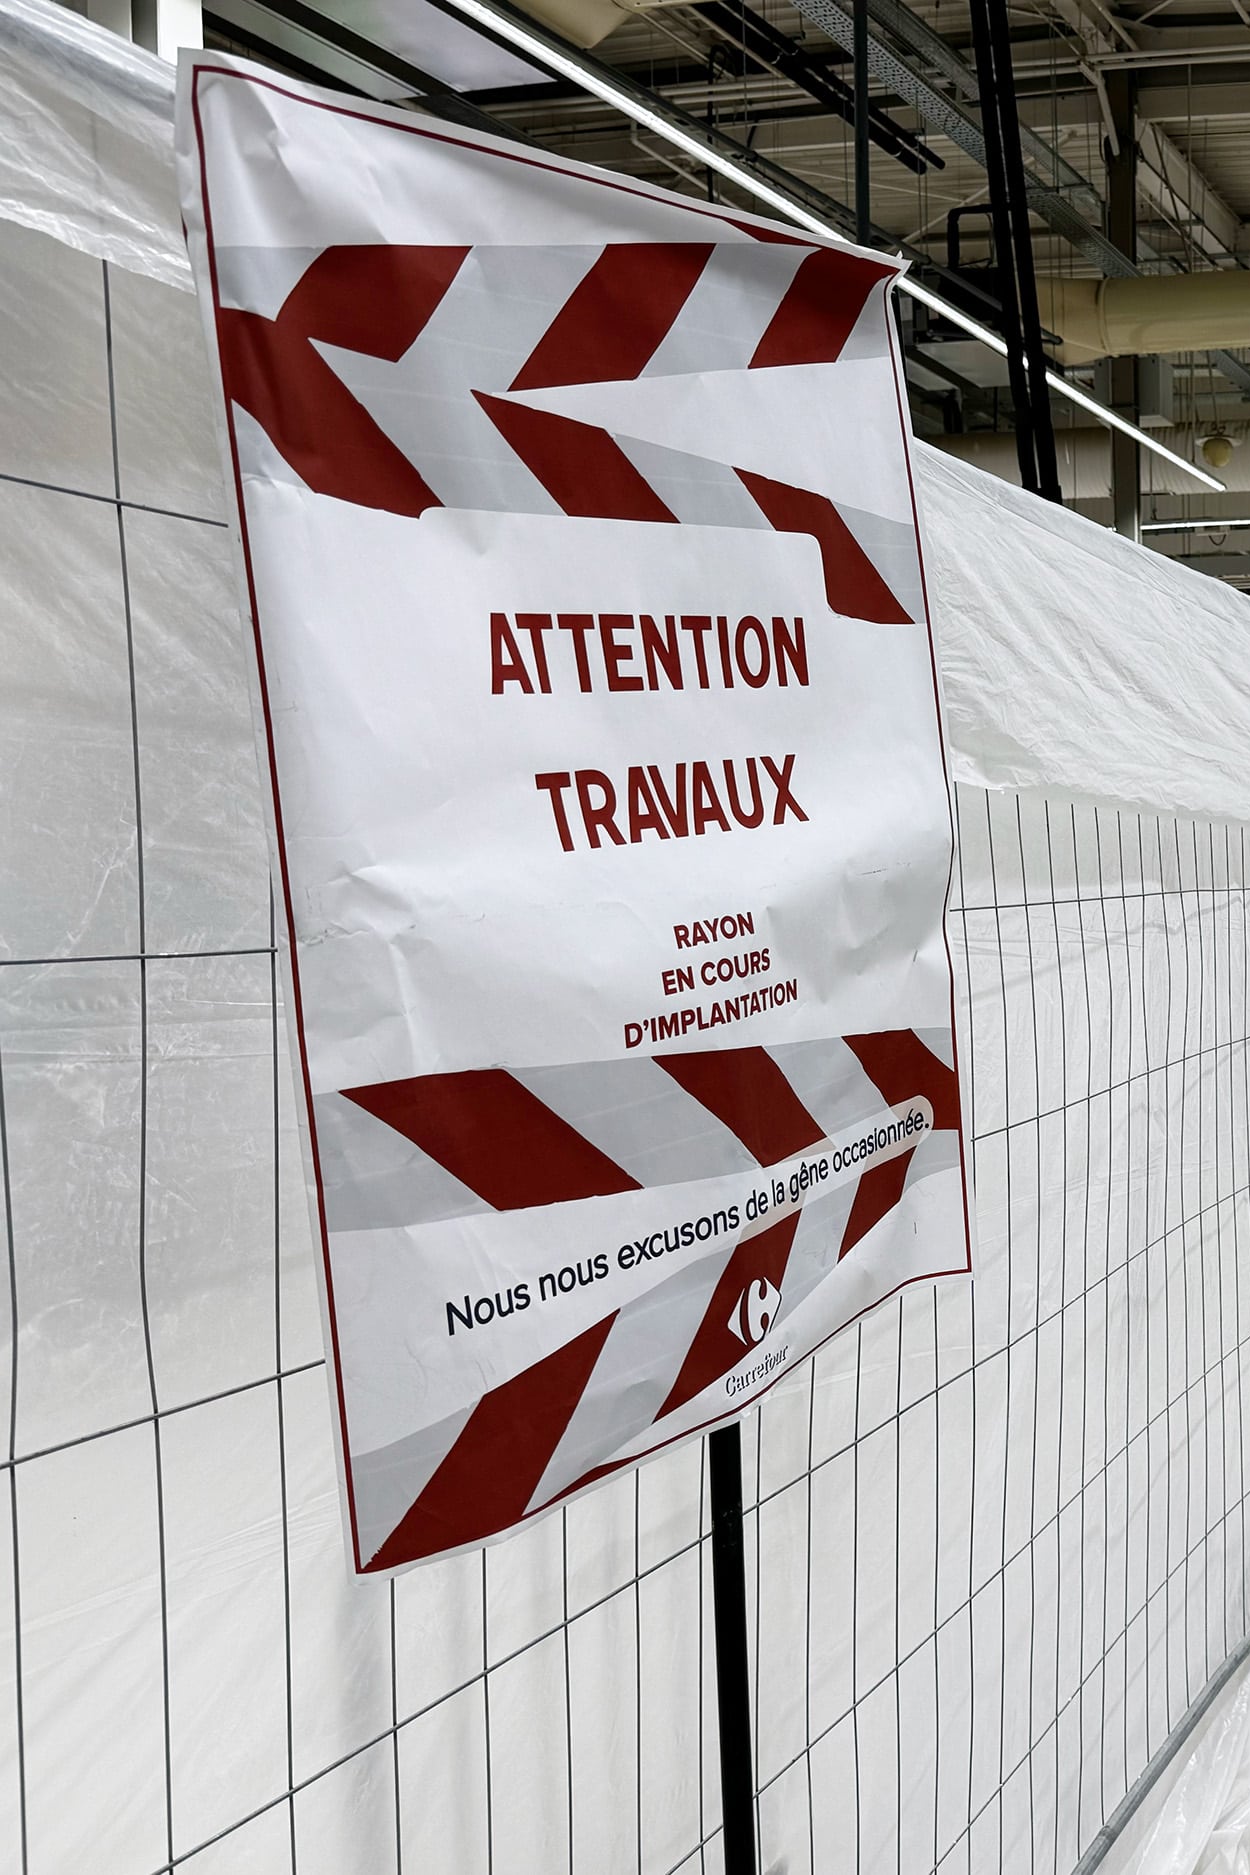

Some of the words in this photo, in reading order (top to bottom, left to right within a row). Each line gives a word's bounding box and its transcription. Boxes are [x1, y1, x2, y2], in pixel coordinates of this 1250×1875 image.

[490, 612, 810, 694] ATTENTION
[535, 754, 810, 852] TRAVAUX
[673, 912, 755, 949] RAYON
[661, 965, 695, 996] EN
[701, 948, 771, 986] COURS
[624, 978, 798, 1049] D’IMPLANTATION
[446, 1283, 531, 1337] Nous
[538, 1253, 609, 1302] nous
[617, 1205, 740, 1270] excusons
[745, 1189, 769, 1221] de
[771, 1179, 785, 1207] la
[789, 1161, 829, 1203] gêne
[832, 1108, 931, 1173] occasionnée.
[725, 1345, 789, 1398] Carrefour
